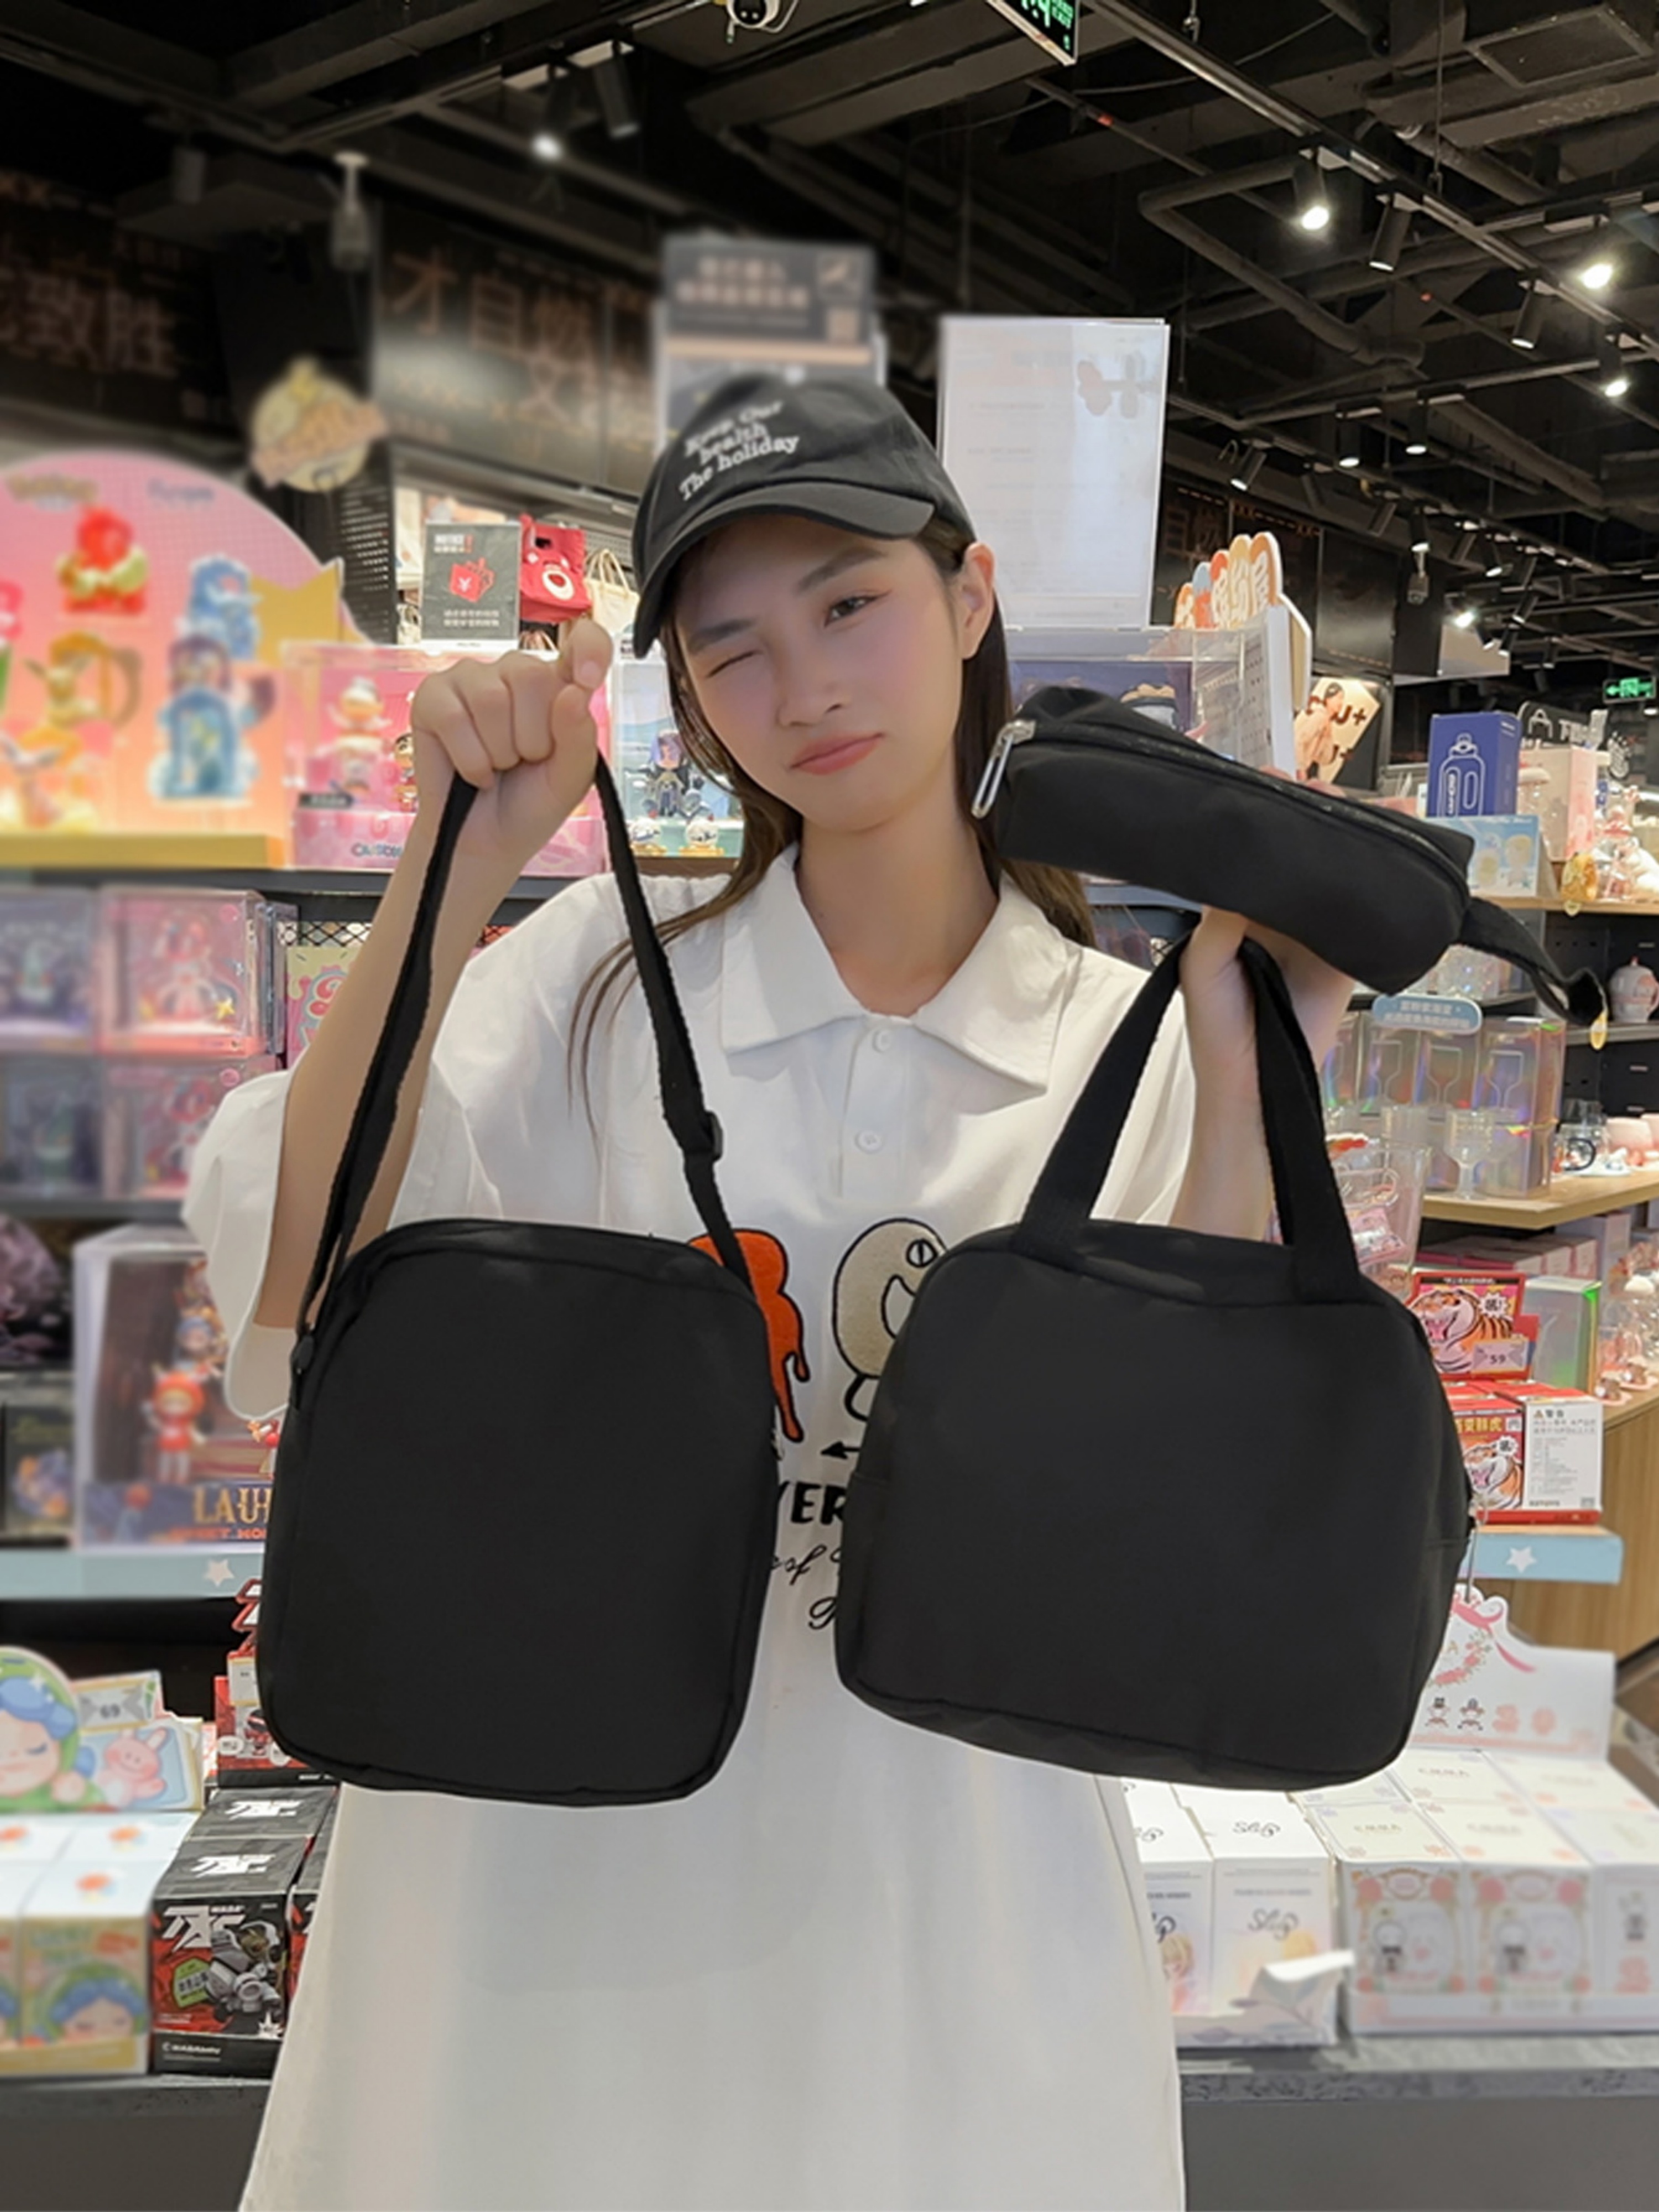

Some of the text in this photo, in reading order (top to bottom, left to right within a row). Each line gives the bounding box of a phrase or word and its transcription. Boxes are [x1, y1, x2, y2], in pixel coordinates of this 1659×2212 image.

[698, 422, 769, 466] health
[679, 435, 800, 502] The holiday
[1489, 1354, 1506, 1364] 59
